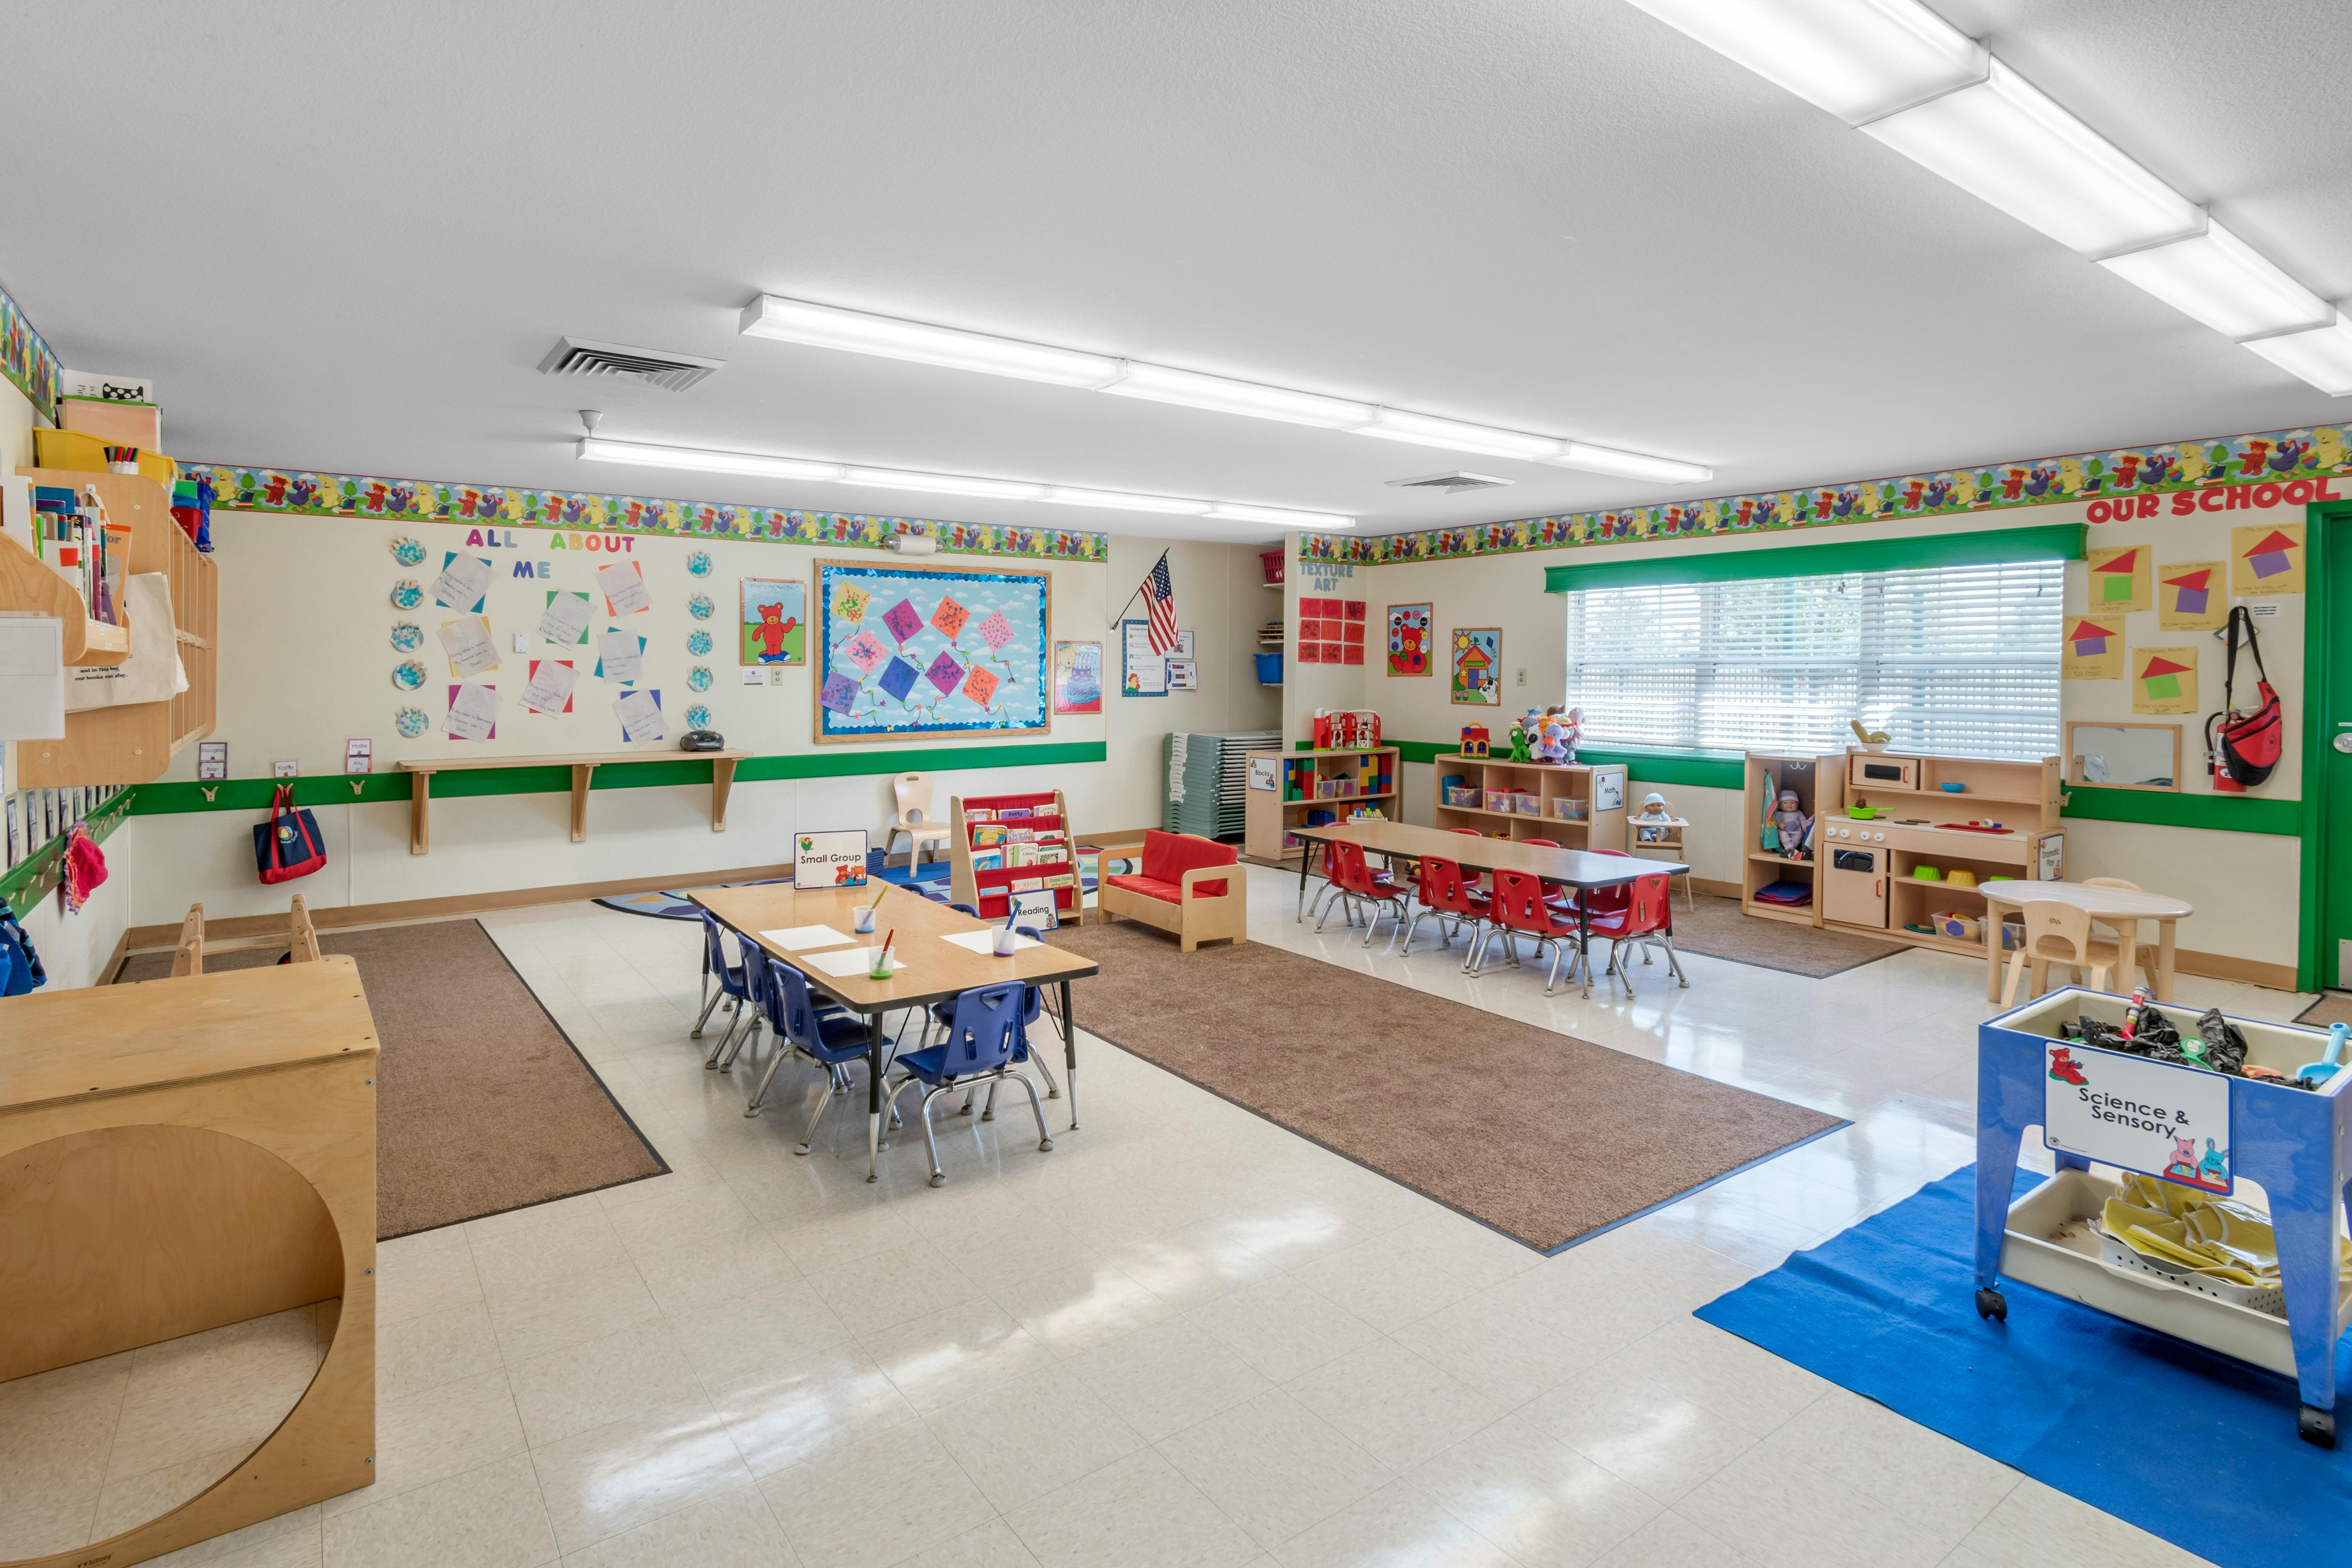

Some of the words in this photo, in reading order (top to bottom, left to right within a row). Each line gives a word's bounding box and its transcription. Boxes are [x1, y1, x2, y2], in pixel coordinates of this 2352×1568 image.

[2087, 494, 2160, 524] OUR
[2171, 476, 2341, 516] SCHOOL
[466, 529, 518, 548] ALL
[550, 532, 635, 553] ABOUT
[513, 561, 550, 579] ME
[1299, 562, 1354, 577] TEXTURE
[1314, 577, 1339, 592] ART
[801, 855, 827, 864] Small
[831, 854, 861, 862] Group
[2042, 848, 2060, 858] Dramatic
[1018, 906, 1049, 916] Reading
[2078, 1088, 2167, 1119] Science
[2175, 1111, 2190, 1125] &
[2091, 1105, 2176, 1139] Sensory
